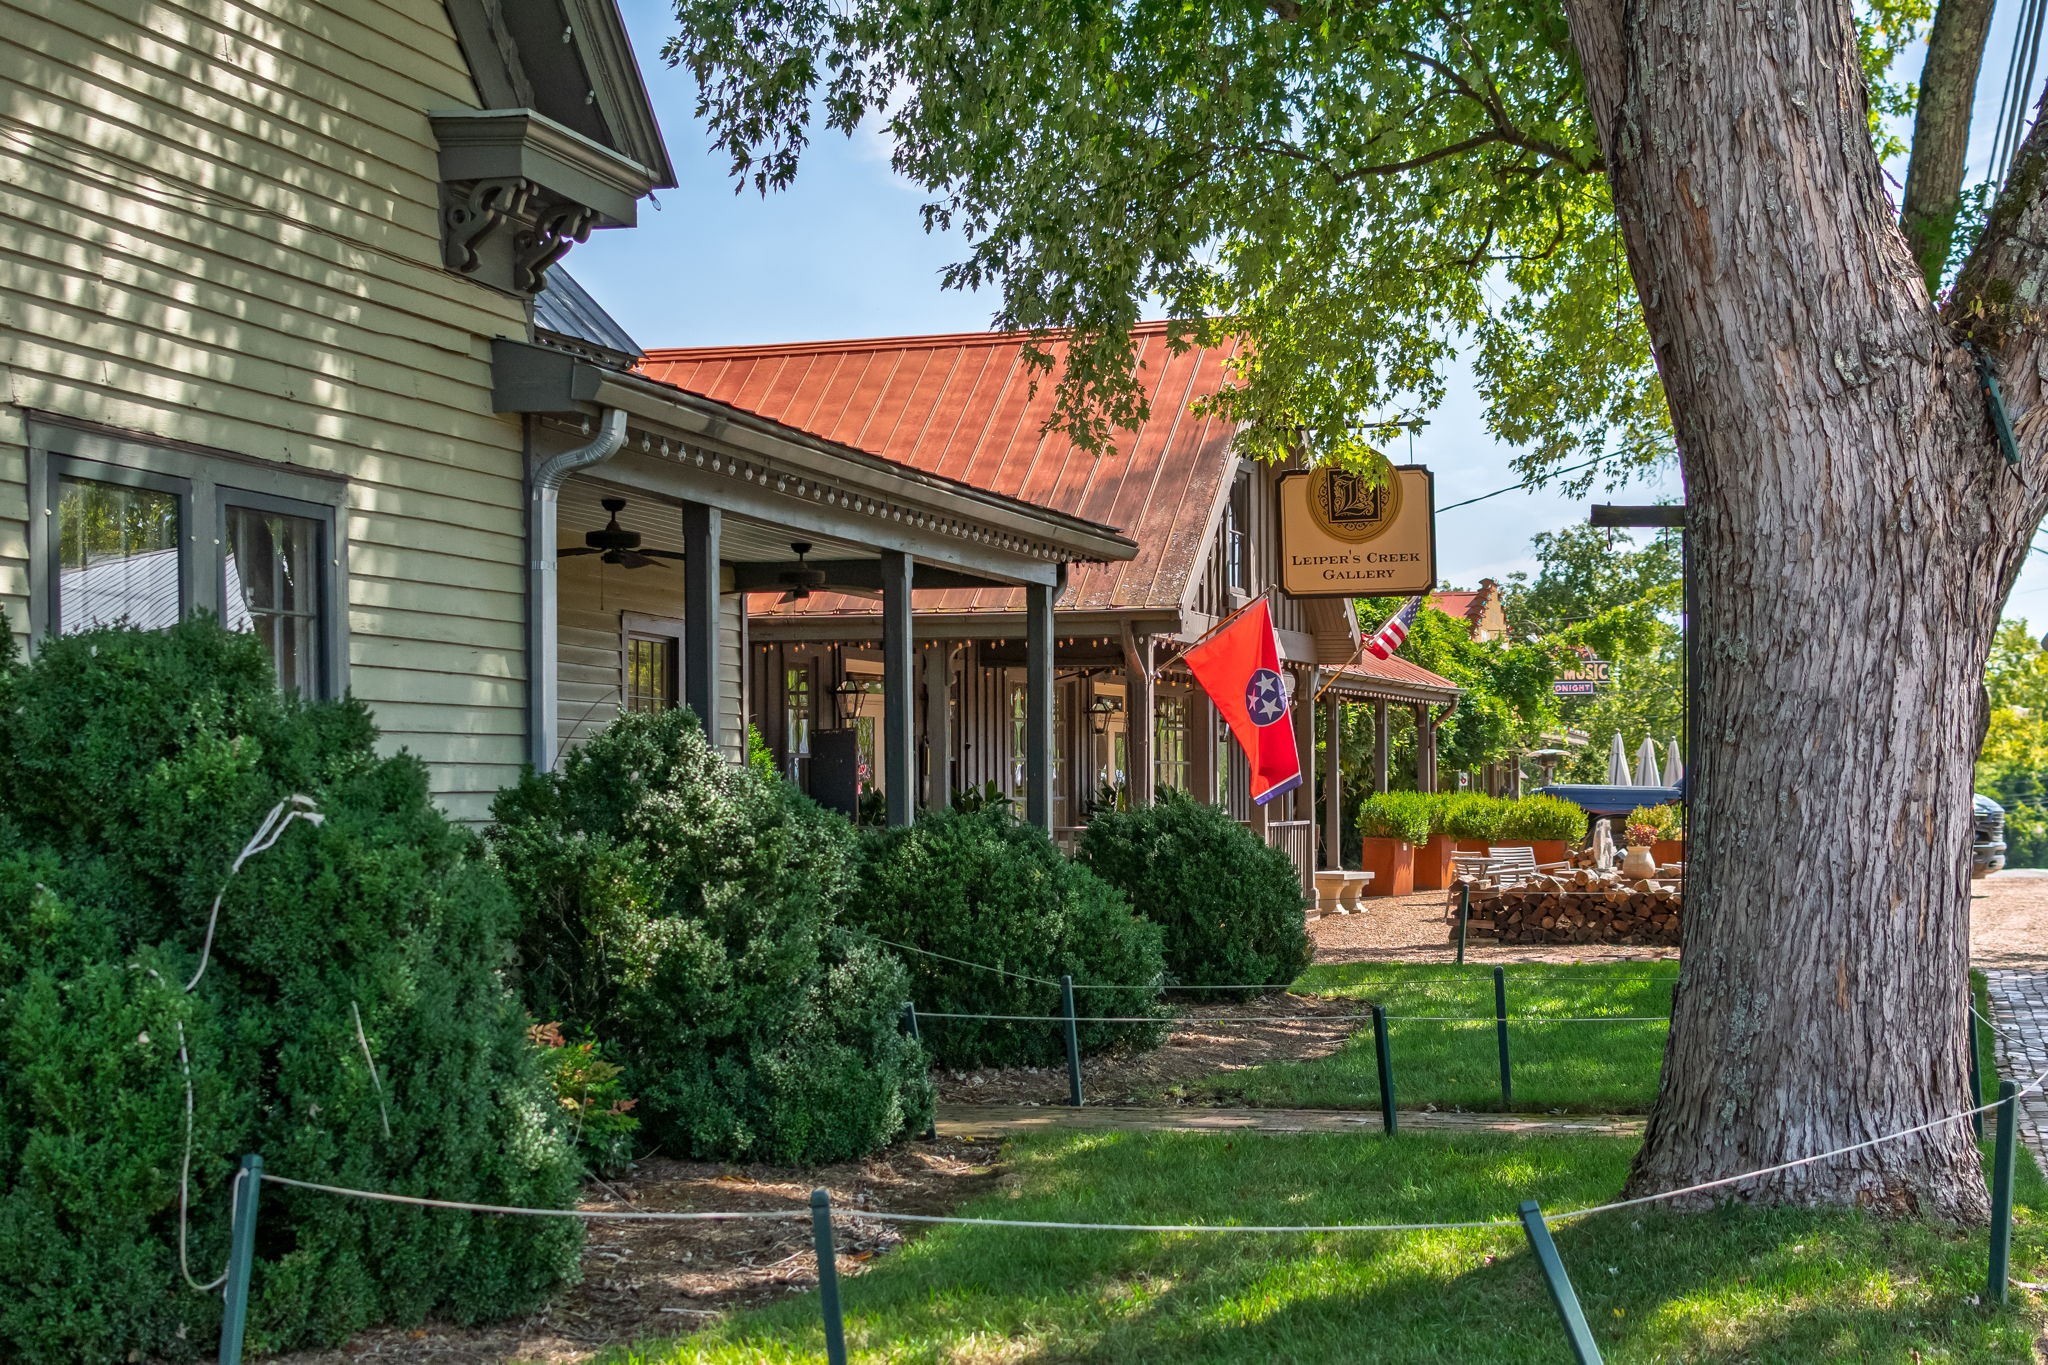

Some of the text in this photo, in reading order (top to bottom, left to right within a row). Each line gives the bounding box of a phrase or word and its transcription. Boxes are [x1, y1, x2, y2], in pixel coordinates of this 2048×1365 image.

[1292, 549, 1421, 566] LEIPER'S CREEK
[1322, 569, 1396, 580] GALLERY
[1552, 684, 1591, 692] ONIGHT
